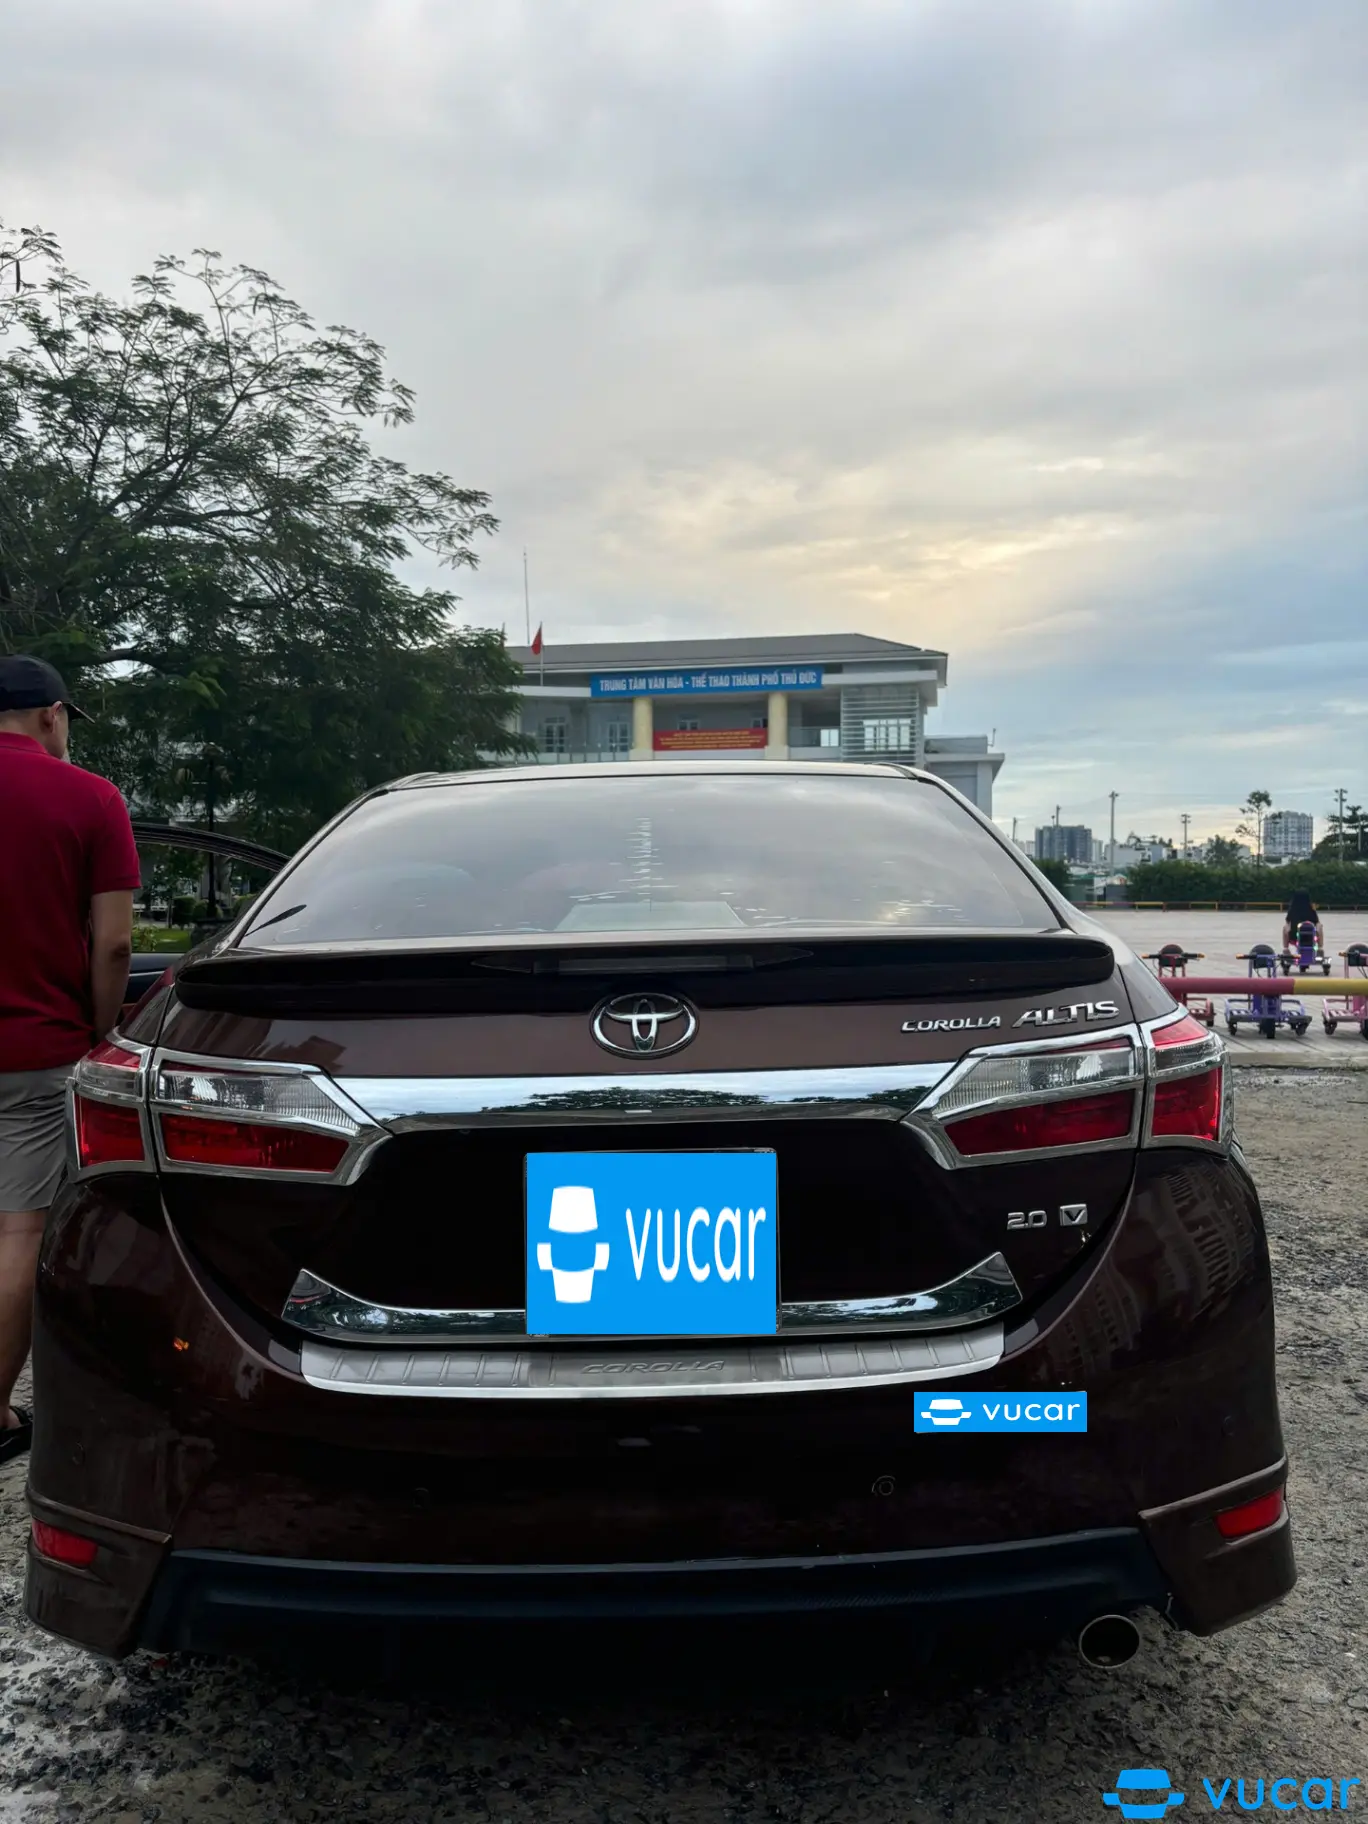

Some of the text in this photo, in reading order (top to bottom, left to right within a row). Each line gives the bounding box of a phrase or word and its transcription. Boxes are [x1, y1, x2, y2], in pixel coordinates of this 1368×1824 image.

[600, 680, 627, 692] TRUNG
[629, 677, 646, 690] TÂM
[648, 676, 665, 689] VĂN
[708, 674, 730, 687] THAO
[732, 672, 760, 686] THÀNH
[901, 1000, 1120, 1033] COROLLA ALTIS
[1007, 1206, 1087, 1230] 2.0 V
[581, 1360, 725, 1375] COROLLA
